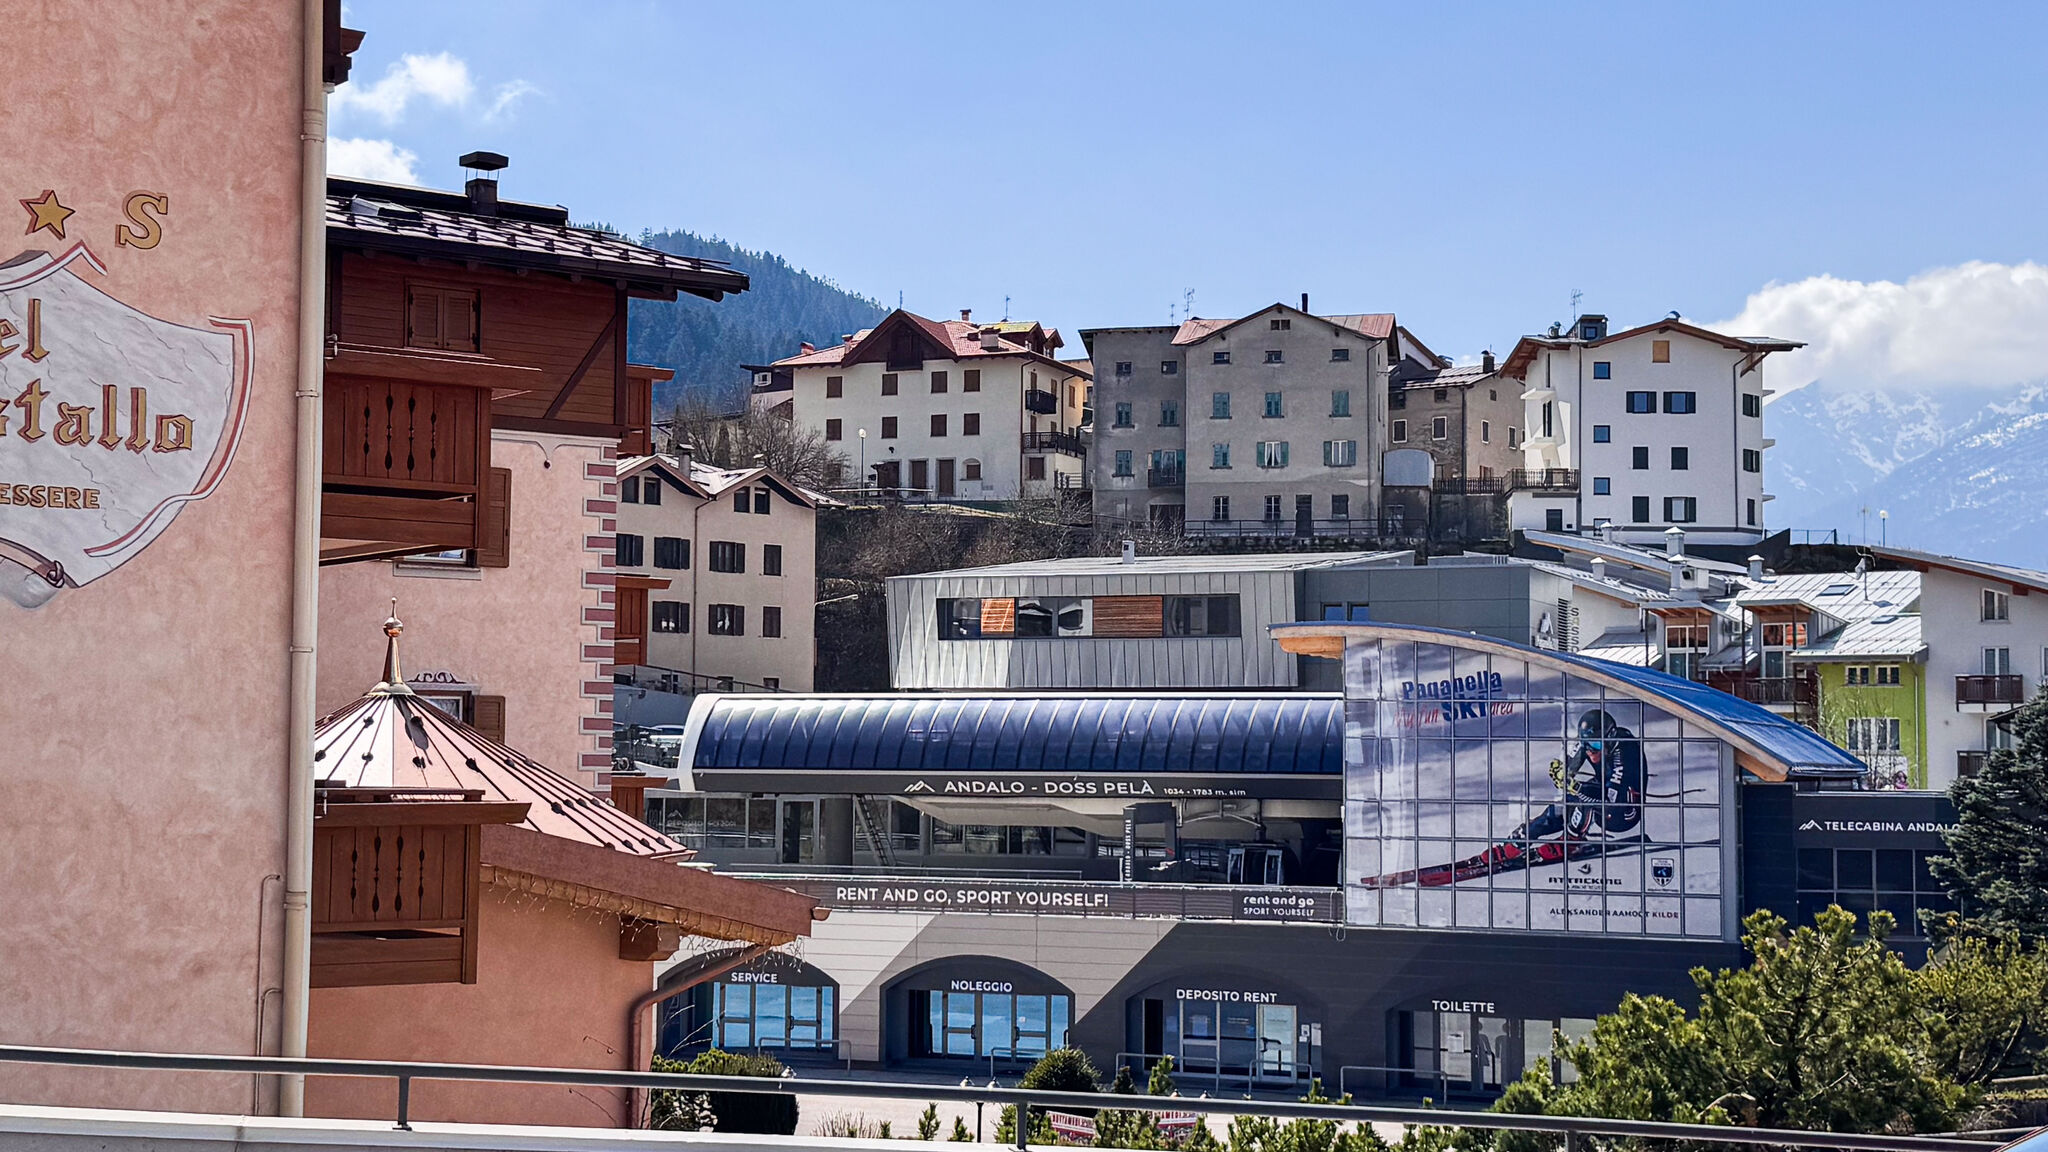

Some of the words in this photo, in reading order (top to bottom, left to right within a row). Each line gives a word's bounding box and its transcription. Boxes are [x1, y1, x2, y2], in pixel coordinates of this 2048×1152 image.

[115, 189, 168, 249] S
[1402, 670, 1502, 699] Paganella
[1440, 694, 1487, 721] SKI
[944, 781, 1025, 794] ANDALO
[1044, 781, 1097, 795] DOSS
[1104, 780, 1155, 795] PELÀ
[1824, 821, 1904, 832] TELECABINA
[836, 887, 878, 901] RENT
[883, 888, 919, 902] AND
[923, 889, 952, 905] GO,
[956, 890, 1012, 905] SPORT
[1015, 891, 1109, 907] YOURSELF!
[1243, 907, 1270, 915] SPORT
[1273, 908, 1315, 917] YOURSELF
[1652, 911, 1680, 919] KILDE
[731, 971, 778, 984] SERVICE
[950, 979, 1013, 993] NOLEGGIO
[1175, 989, 1240, 1002] DEPOSITO
[1243, 992, 1278, 1004] RENT
[1431, 1000, 1496, 1014] TOILETTE
